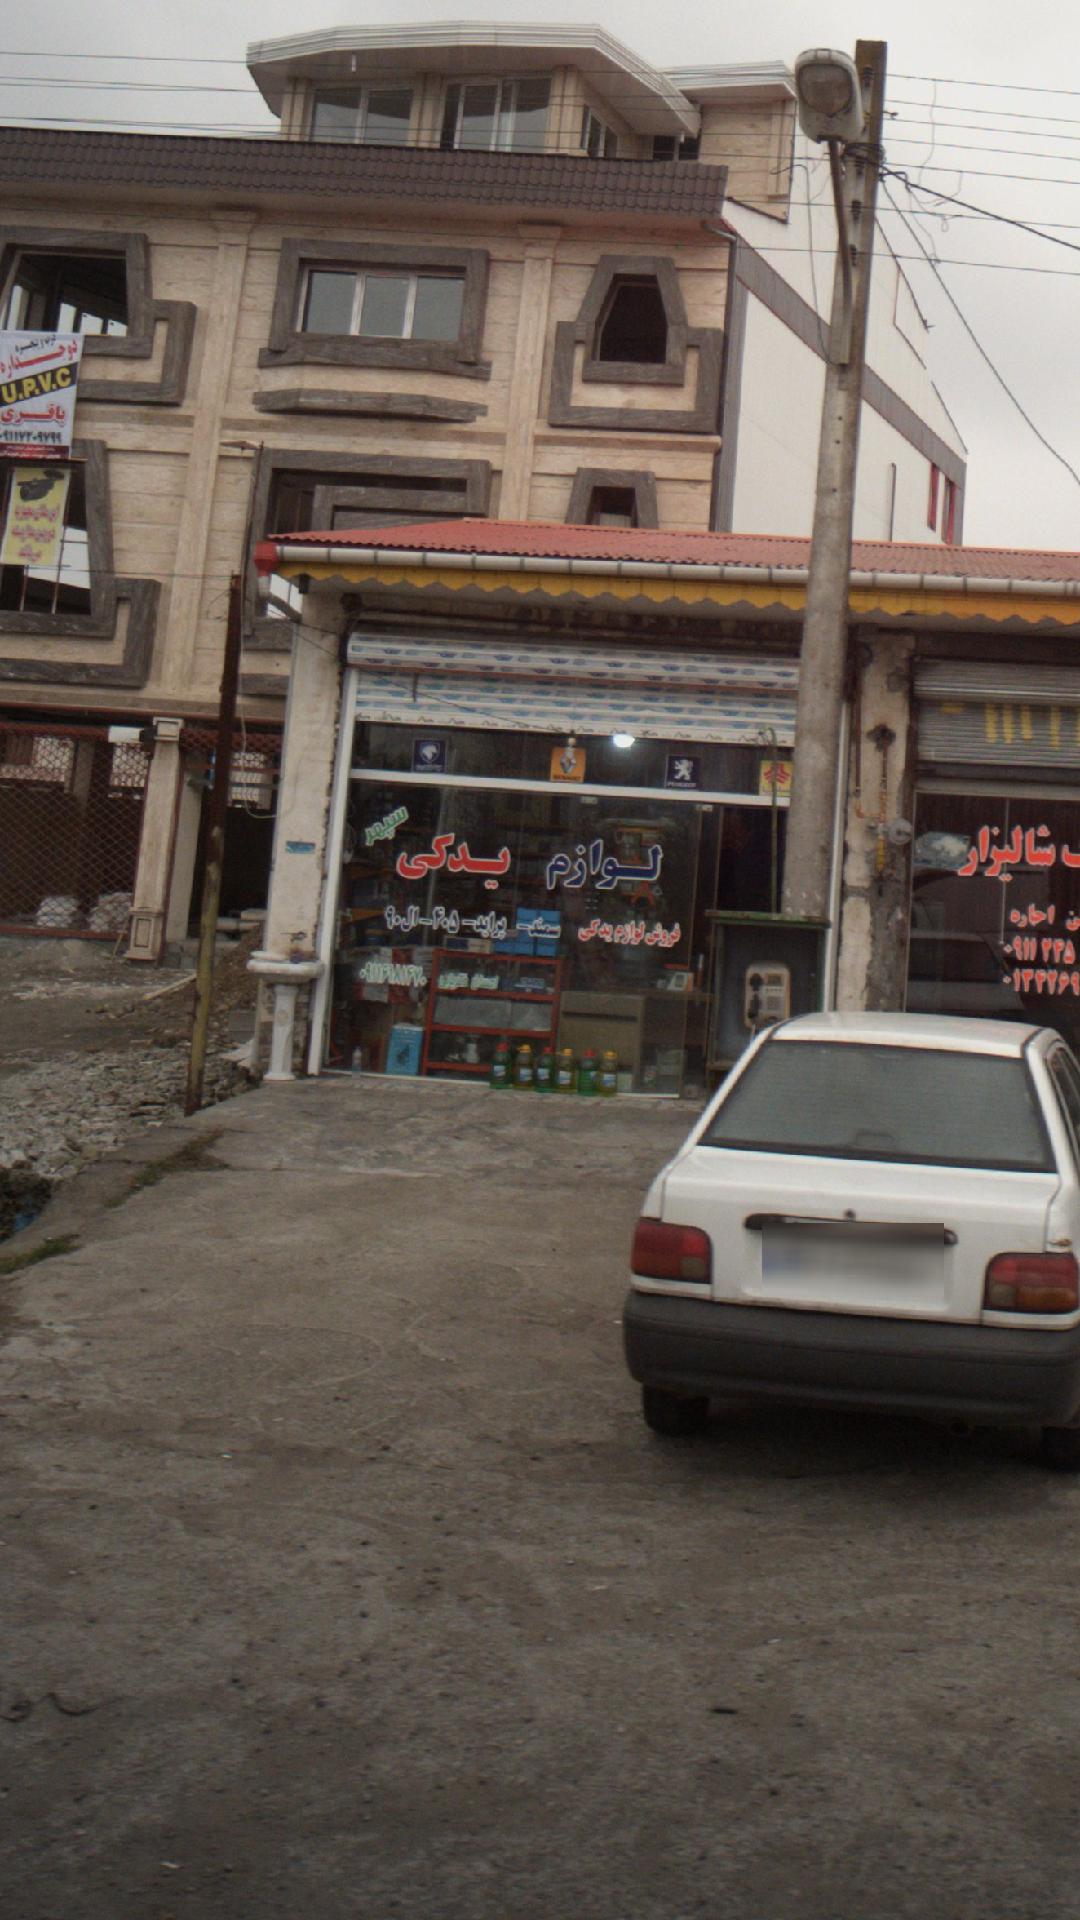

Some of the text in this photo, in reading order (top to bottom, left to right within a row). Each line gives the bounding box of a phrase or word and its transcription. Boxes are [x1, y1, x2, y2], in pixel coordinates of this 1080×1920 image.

[1, 366, 72, 404] U.P.V.C
[395, 832, 664, 891] لوازم یدکی
[957, 824, 1056, 882] شالیزار
[577, 918, 682, 948] فروش لوازم یدکی
[1009, 903, 1056, 928] اجاره
